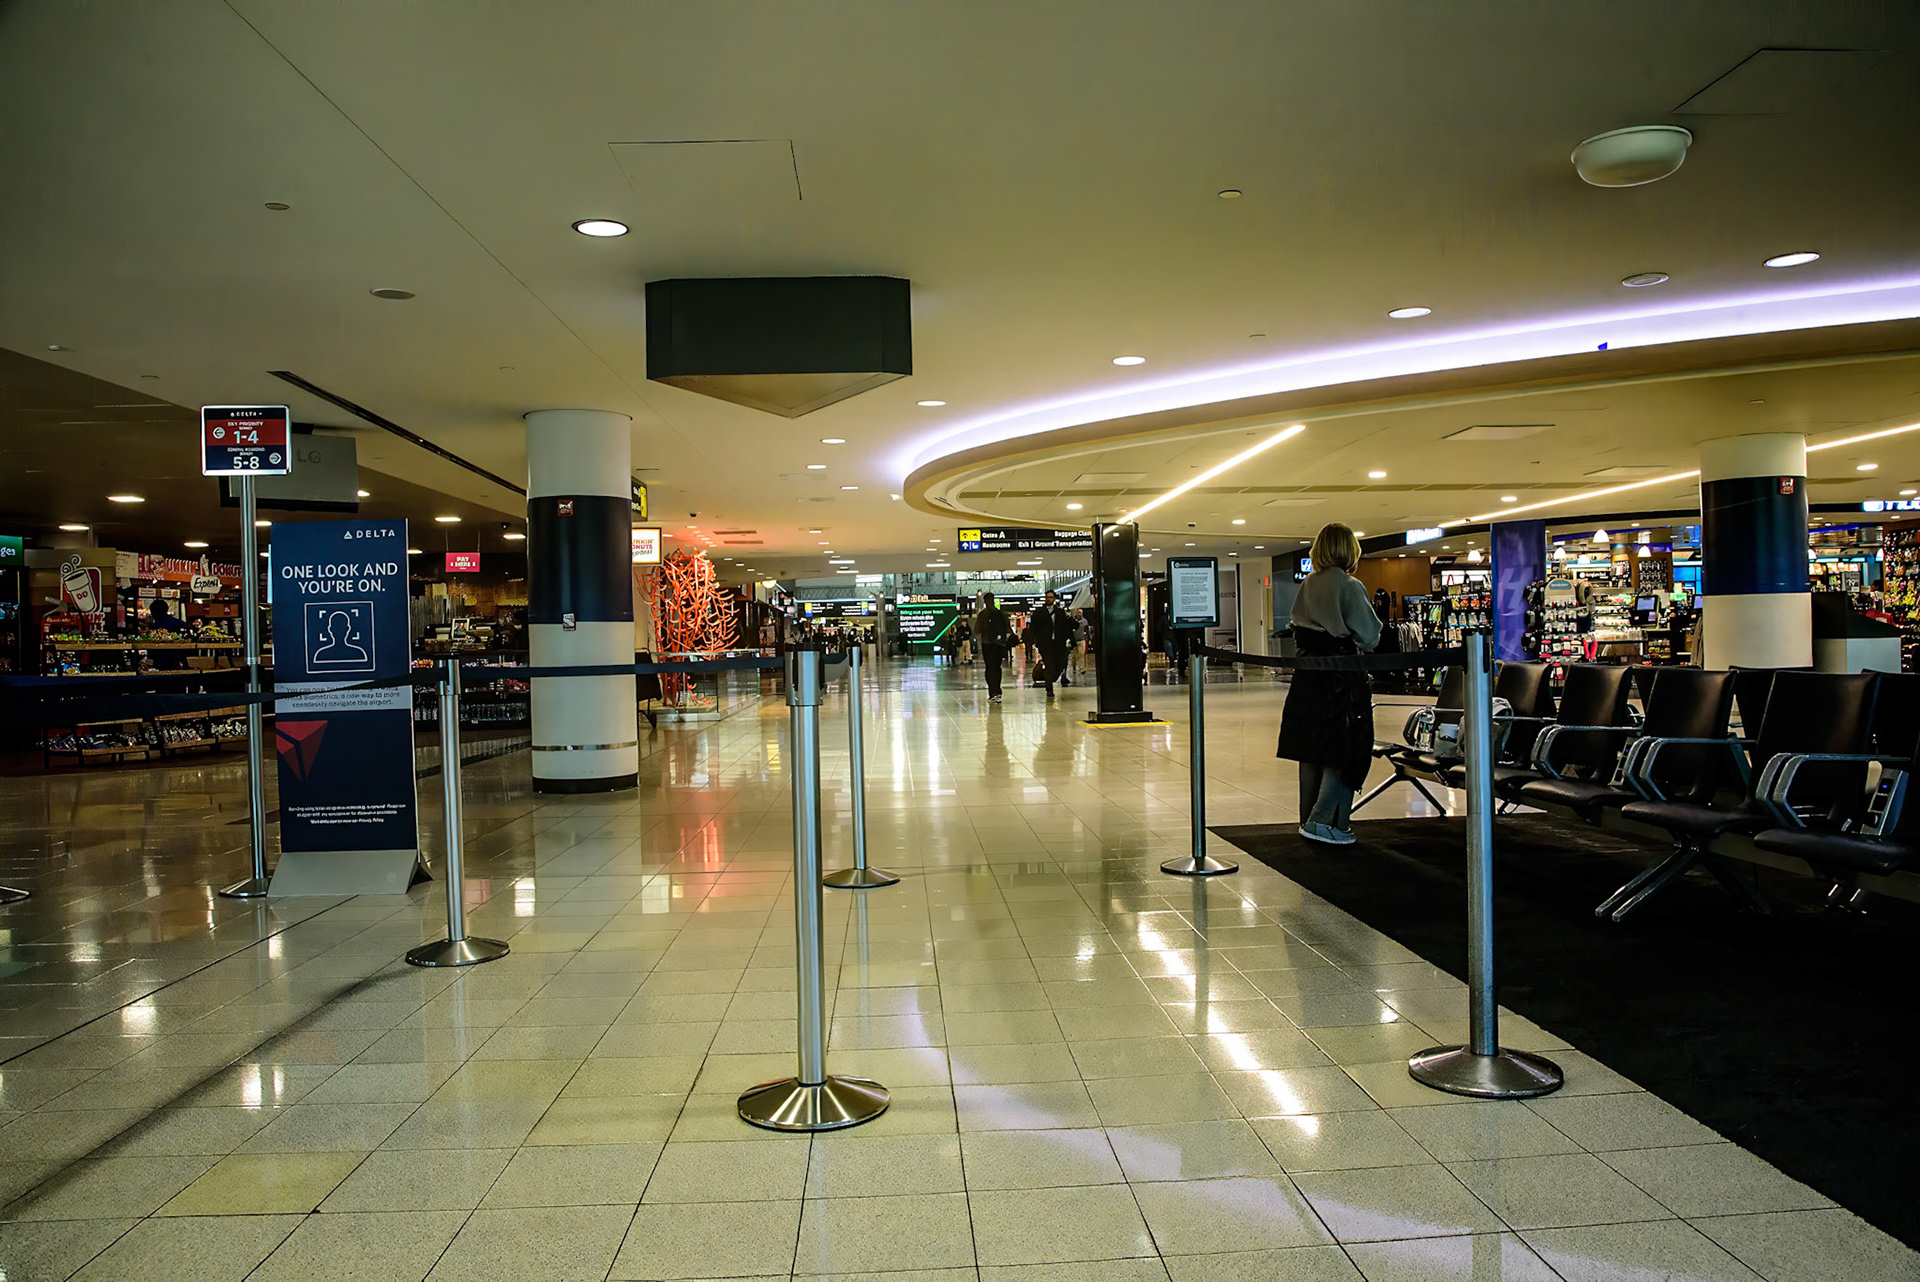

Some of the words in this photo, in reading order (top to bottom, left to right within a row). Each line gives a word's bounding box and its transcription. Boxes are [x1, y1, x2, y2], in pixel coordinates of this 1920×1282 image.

[233, 430, 259, 444] 1-4
[296, 449, 322, 464] LG
[233, 456, 260, 470] 5-8
[356, 528, 396, 539] DELTA
[998, 531, 1006, 539] A
[1054, 530, 1077, 538] Baggage
[164, 557, 199, 576] UNKIN'
[281, 565, 314, 579] ONE
[317, 563, 360, 578] LOOK
[363, 562, 398, 576] AND
[298, 579, 354, 594] YOU'RE
[358, 578, 386, 593] ON.
[76, 590, 89, 600] DD
[361, 692, 374, 700] way
[328, 700, 357, 708] navigate
